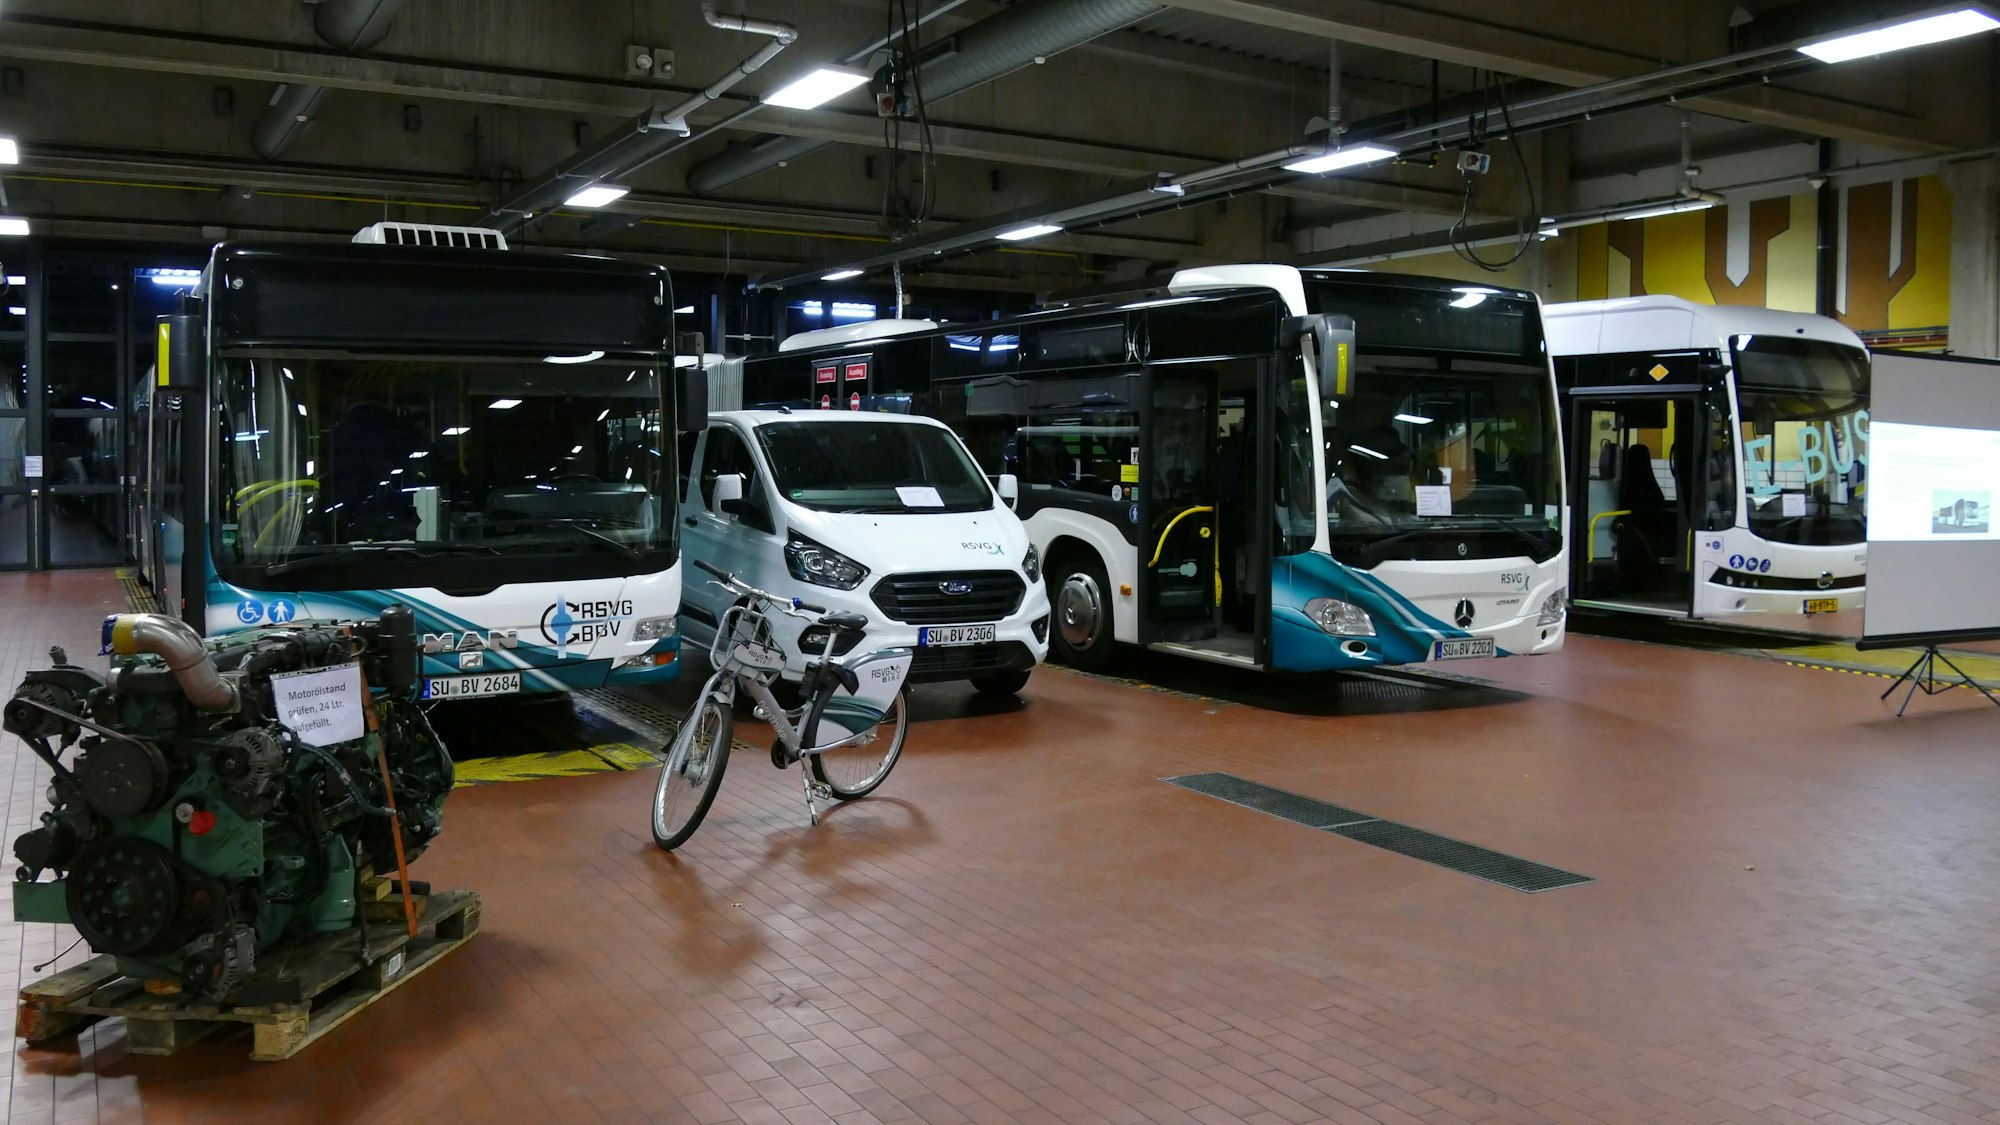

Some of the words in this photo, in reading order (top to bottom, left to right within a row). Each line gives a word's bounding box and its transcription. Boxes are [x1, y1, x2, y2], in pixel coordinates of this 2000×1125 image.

[961, 542, 993, 550] RSVG
[1501, 572, 1523, 584] RSVG
[582, 600, 633, 619] RSVG
[582, 620, 621, 642] BBV
[928, 629, 943, 643] SU
[950, 628, 965, 642] BV
[966, 627, 992, 641] 2306
[423, 630, 518, 654] MAN
[1442, 643, 1455, 657] SU
[1460, 642, 1471, 656] BV
[1471, 641, 1491, 655] 2201
[871, 667, 891, 679] RSVG
[882, 674, 901, 683] BIKE
[288, 681, 346, 701] Motorölstand
[431, 680, 449, 697] SU
[461, 678, 480, 694] BV
[484, 675, 518, 693] 2684
[288, 704, 319, 720] prüfen,
[320, 701, 330, 712] 24
[331, 699, 346, 710] Ltr.
[293, 717, 333, 733] aufgefüllt.
